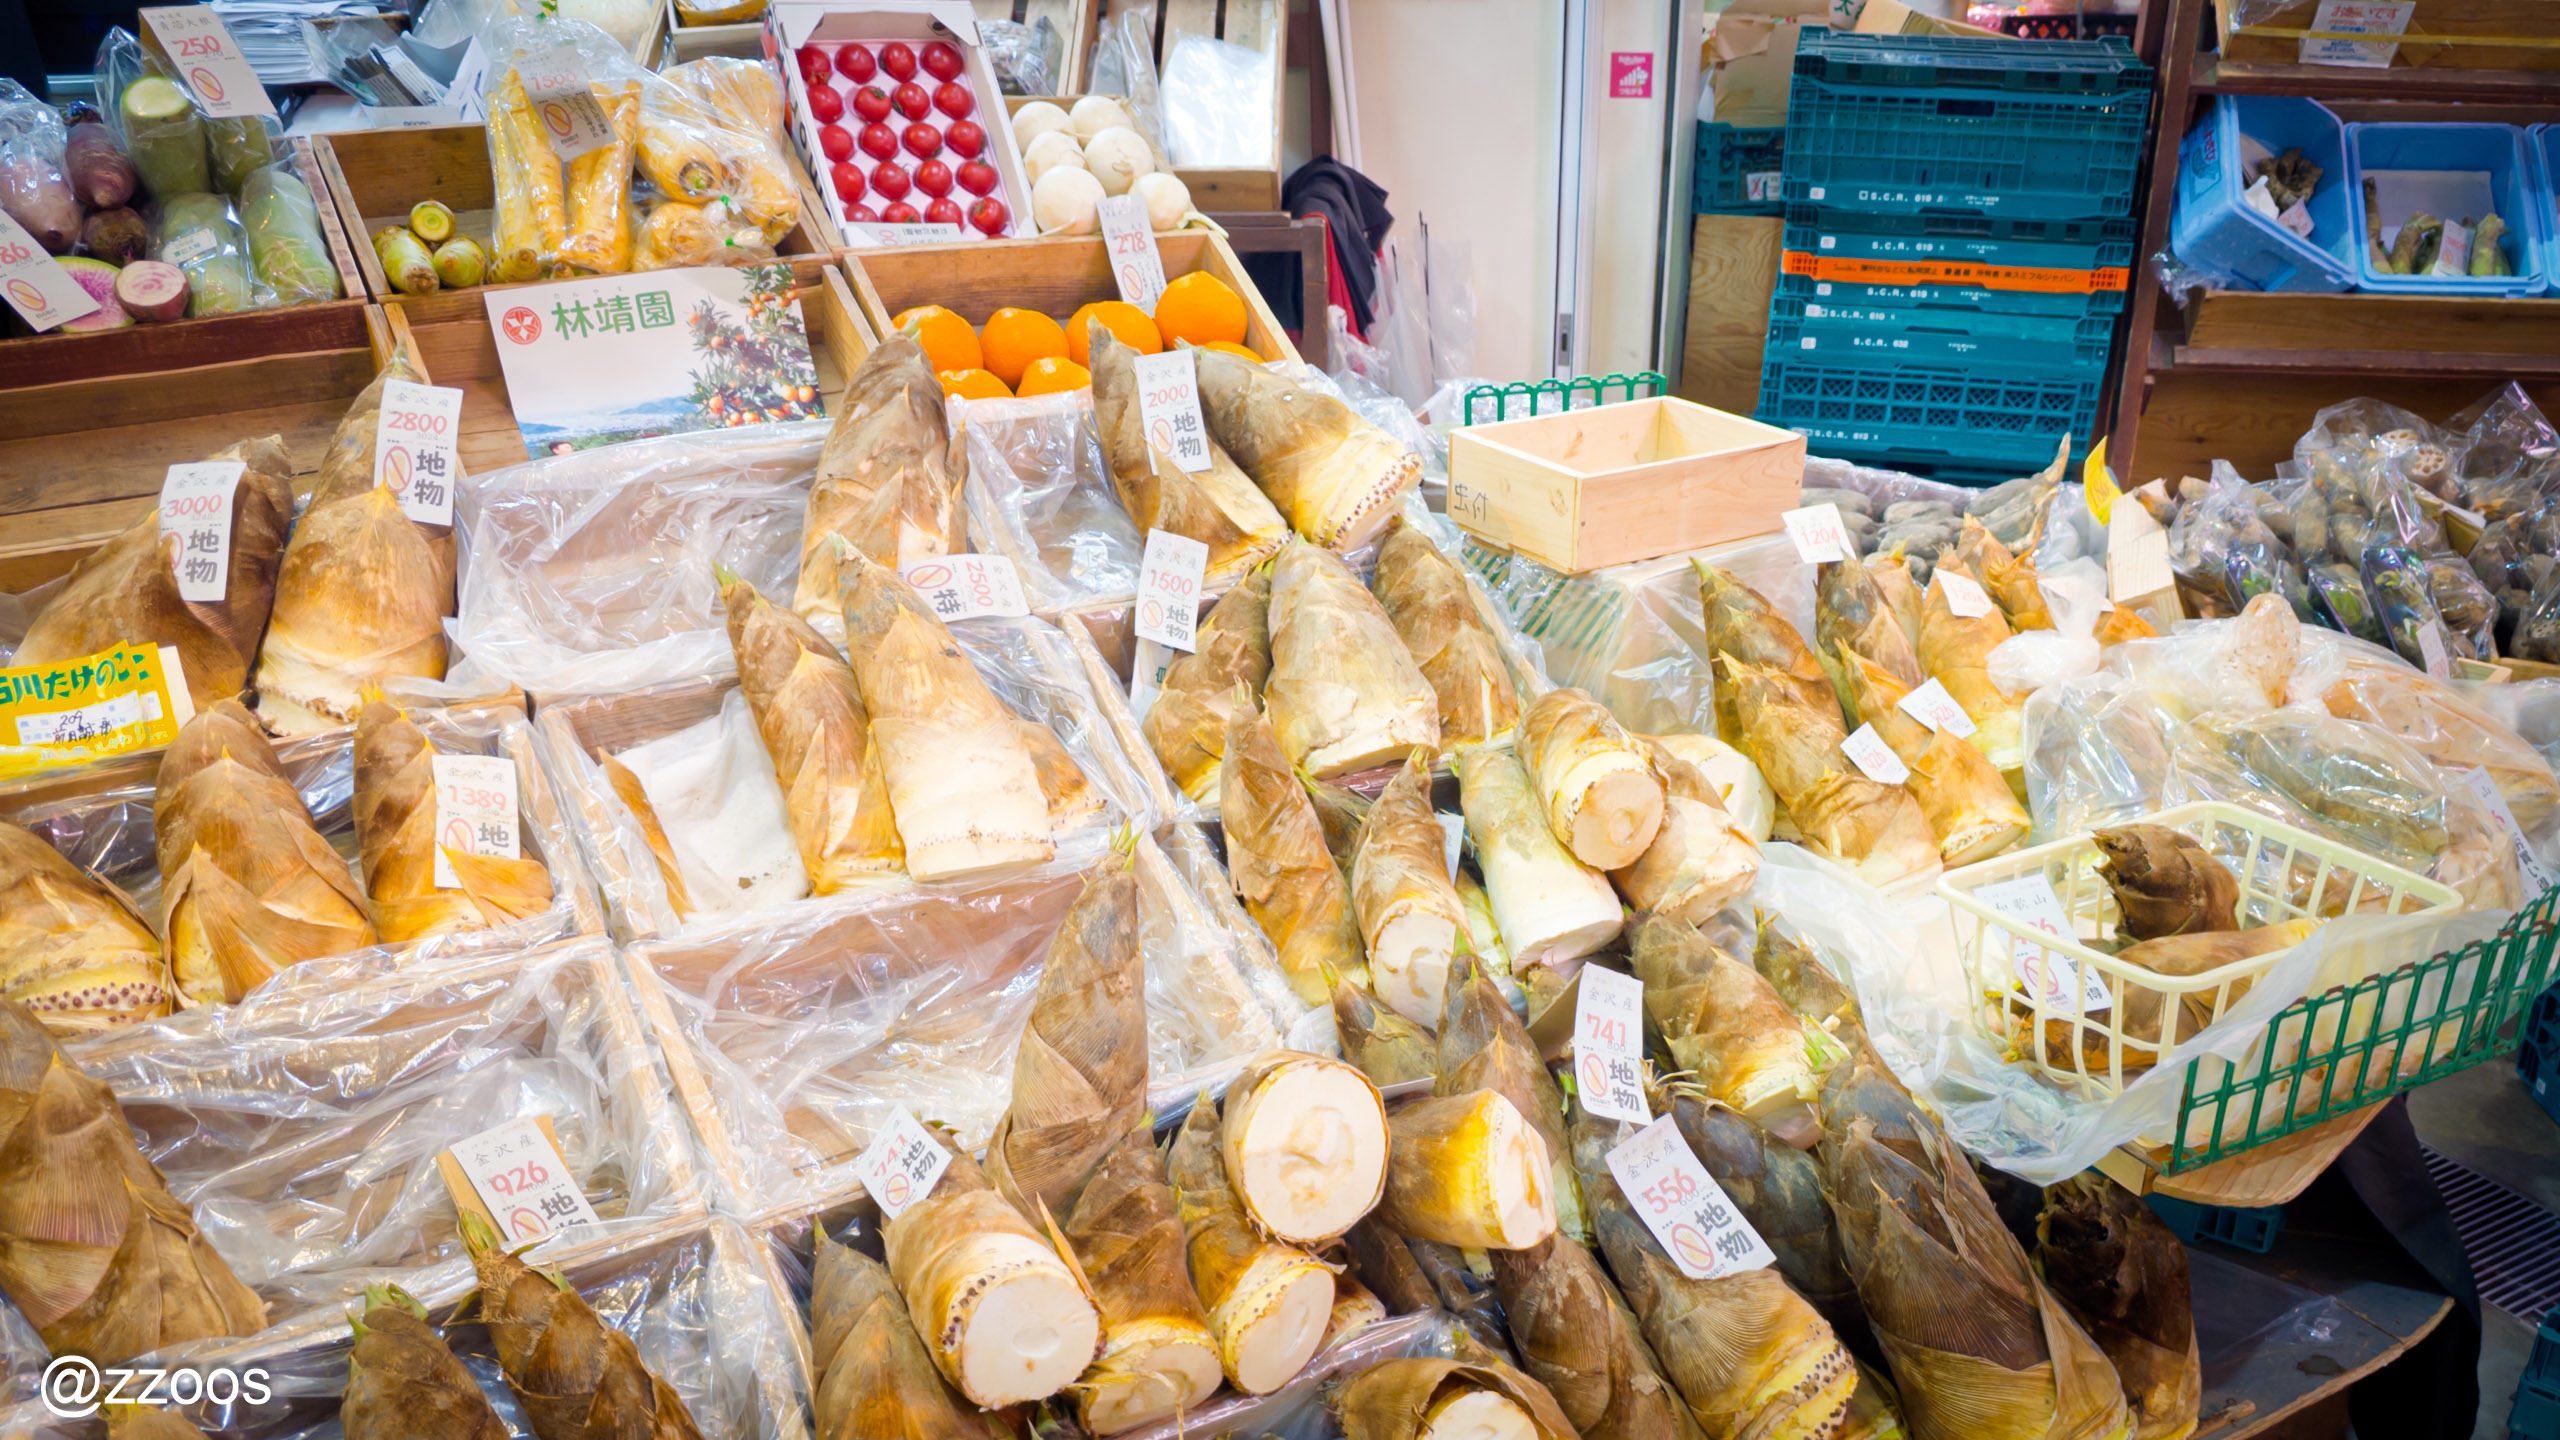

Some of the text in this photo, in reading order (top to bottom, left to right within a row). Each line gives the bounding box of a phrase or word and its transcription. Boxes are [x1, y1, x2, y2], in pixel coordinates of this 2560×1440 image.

[172, 35, 221, 57] 250
[531, 72, 577, 91] 1500
[1114, 231, 1147, 254] 278
[550, 290, 675, 340] 林靖園
[1145, 383, 1189, 409] 2000
[387, 410, 448, 436] 2800
[1172, 411, 1202, 459] 地物
[175, 474, 229, 489] 金沢産
[413, 449, 447, 507] 地物
[164, 494, 223, 519] 3000
[1801, 526, 1841, 548] 1204
[186, 528, 220, 584] 地物
[965, 561, 995, 608] 2500
[1150, 569, 1194, 596] 1500
[932, 588, 962, 614] 特
[1164, 604, 1191, 642] 地物
[447, 784, 507, 812] 1389
[478, 821, 511, 858] 地
[1588, 985, 1634, 1012] 金沢産
[1587, 1012, 1626, 1047] 741
[1609, 1058, 1641, 1112] 地物
[474, 1134, 536, 1167] 金沢産
[873, 1133, 907, 1177] 741
[902, 1140, 938, 1182] 地物
[1626, 1138, 1679, 1181] 金沢産
[490, 1160, 550, 1196] 926
[1644, 1167, 1697, 1214] 556
[1679, 1190, 1701, 1208] 600
[1694, 1202, 1755, 1262] 地物
